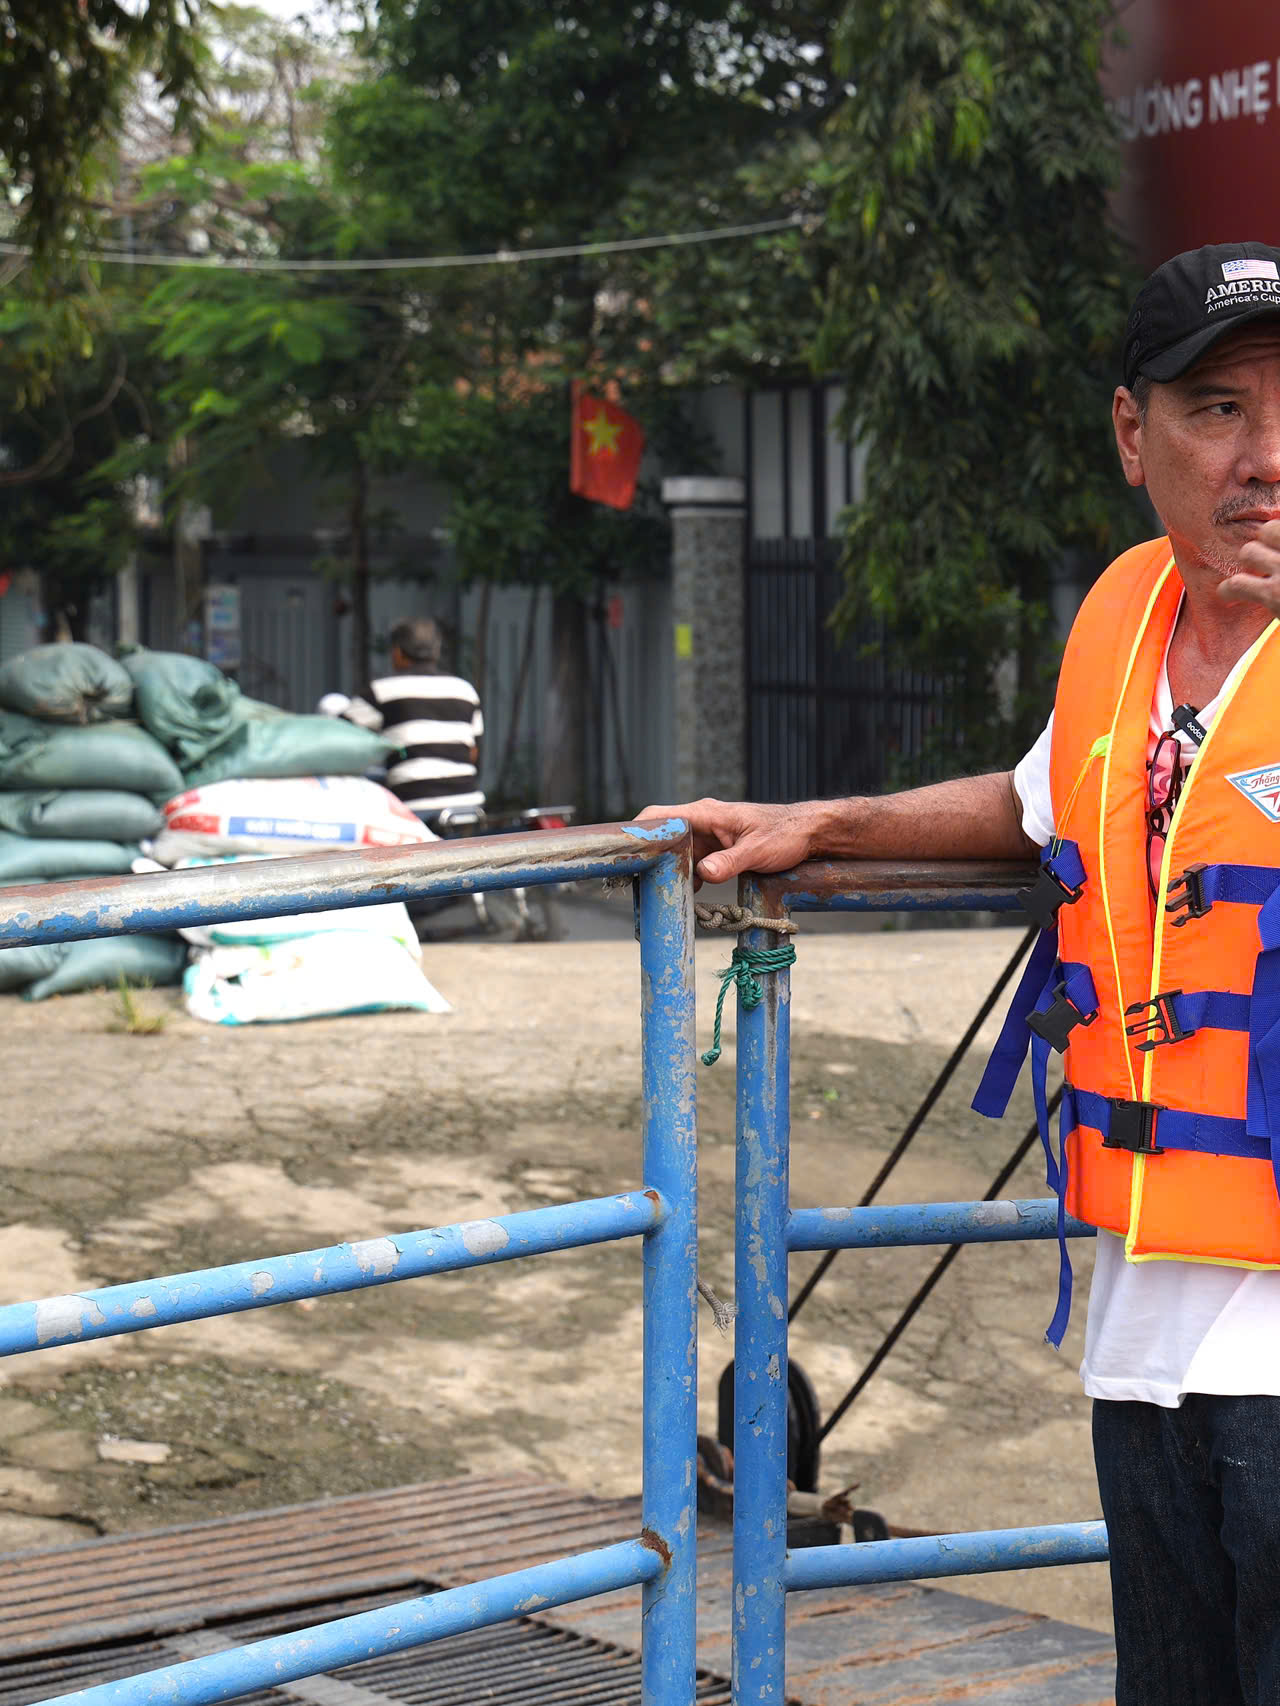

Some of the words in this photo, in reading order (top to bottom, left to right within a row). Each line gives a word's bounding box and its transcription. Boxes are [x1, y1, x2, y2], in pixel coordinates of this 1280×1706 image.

[1209, 61, 1271, 124] NHẸ
[1207, 294, 1259, 313] America's
[1260, 293, 1280, 305] Cup
